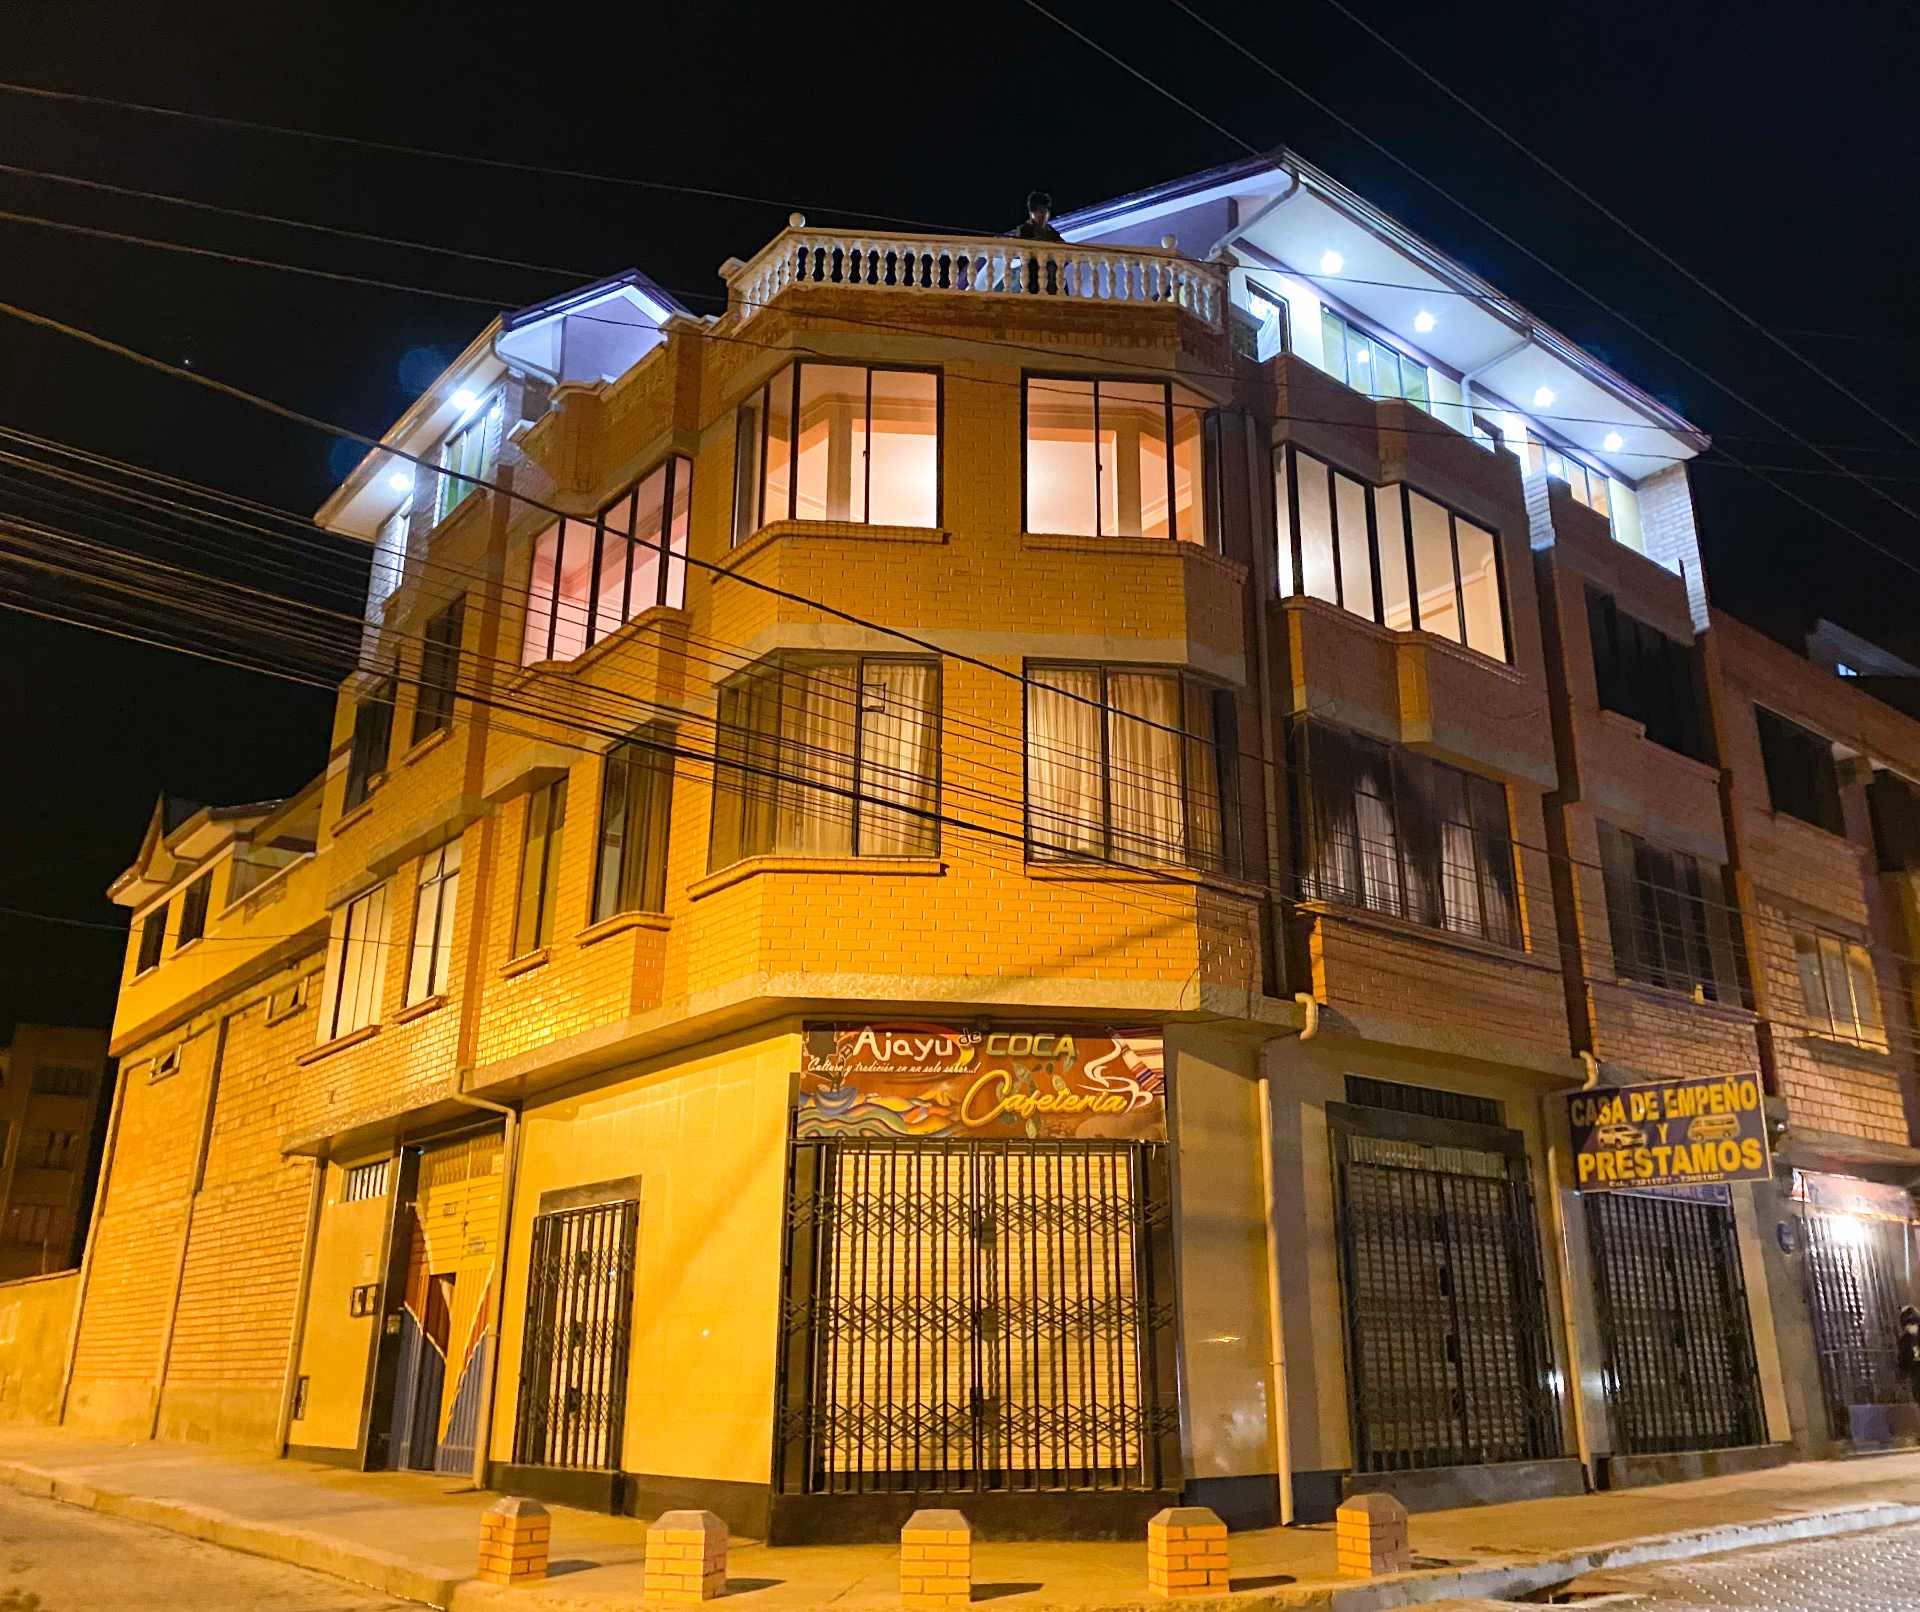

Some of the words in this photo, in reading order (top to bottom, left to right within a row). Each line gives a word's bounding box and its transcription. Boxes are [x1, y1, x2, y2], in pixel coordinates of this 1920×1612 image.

[852, 1025, 954, 1062] Ajayu
[958, 1028, 982, 1046] de
[985, 1032, 1080, 1057] COCA
[896, 1064, 907, 1073] en
[908, 1064, 922, 1073] un
[923, 1060, 943, 1073] solo
[1571, 1095, 1627, 1127] CASA
[1630, 1090, 1660, 1122] DE
[1663, 1076, 1758, 1118] EMPEÑO
[1657, 1122, 1669, 1145] Y
[1577, 1137, 1763, 1183] PRESTAMOS
